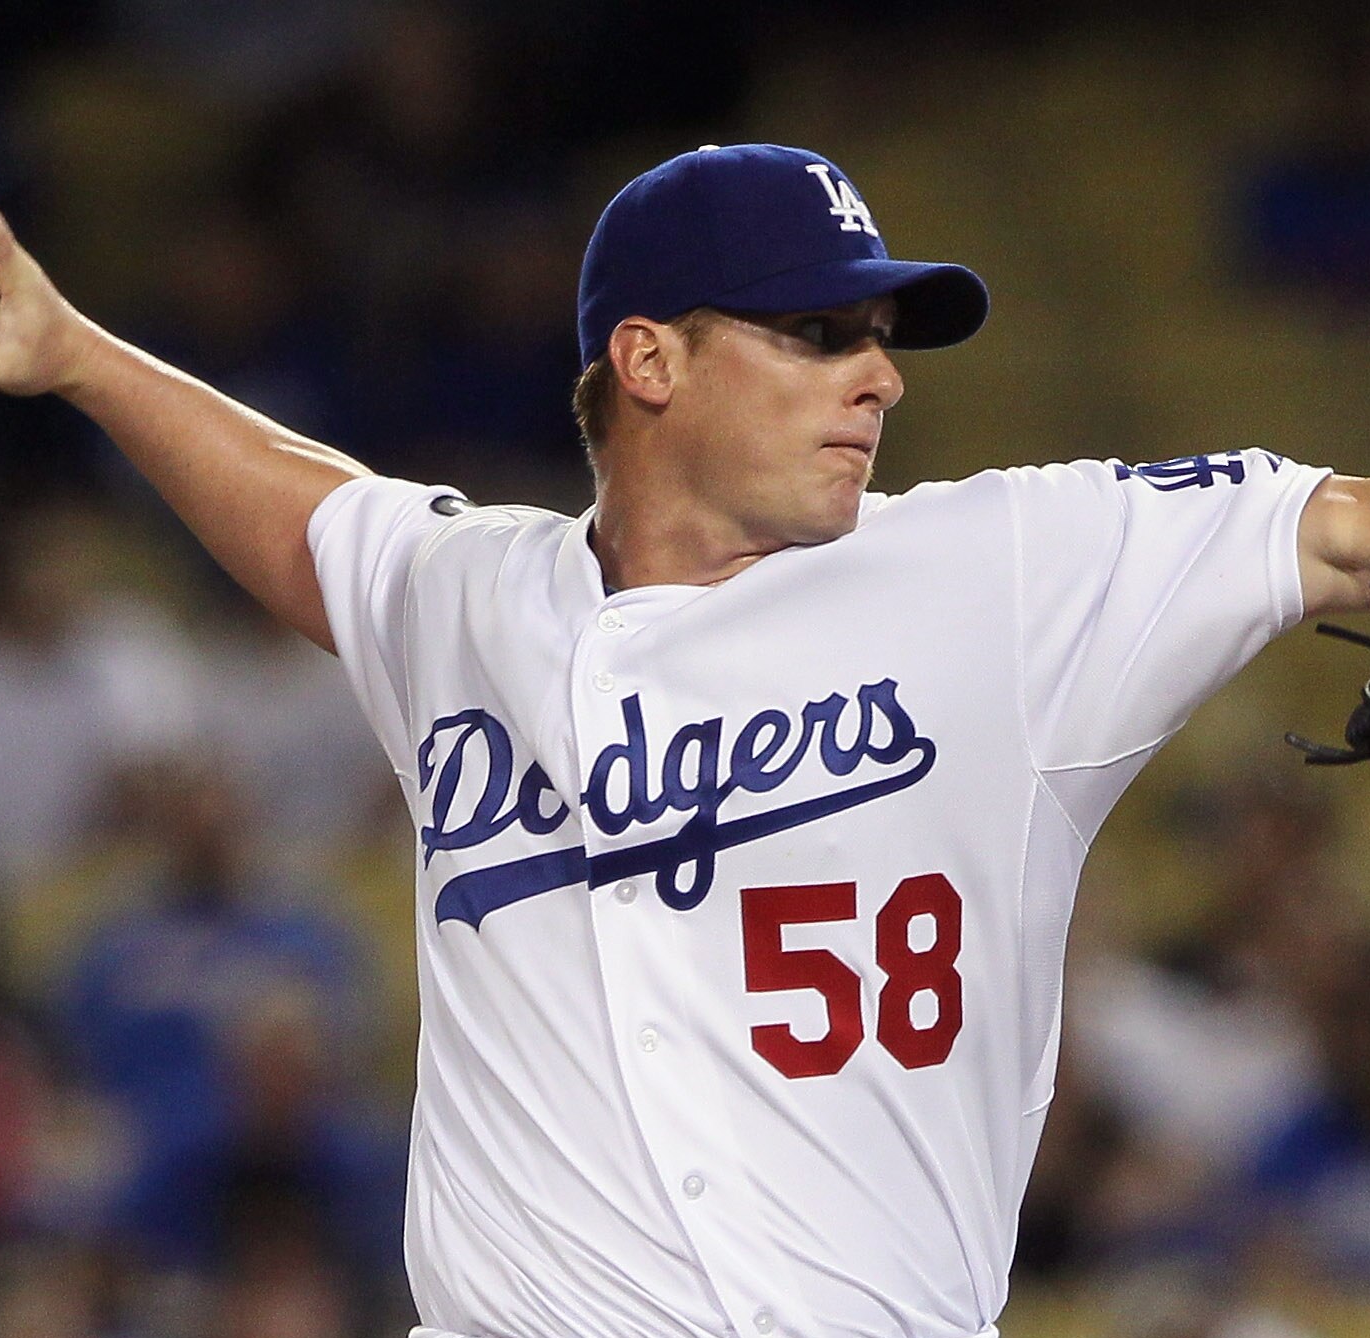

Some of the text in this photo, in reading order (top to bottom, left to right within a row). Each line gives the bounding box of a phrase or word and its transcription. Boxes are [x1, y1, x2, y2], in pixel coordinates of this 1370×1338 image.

[805, 164, 879, 237] LA
[420, 678, 935, 912] Dodgers
[740, 873, 963, 1080] 58
